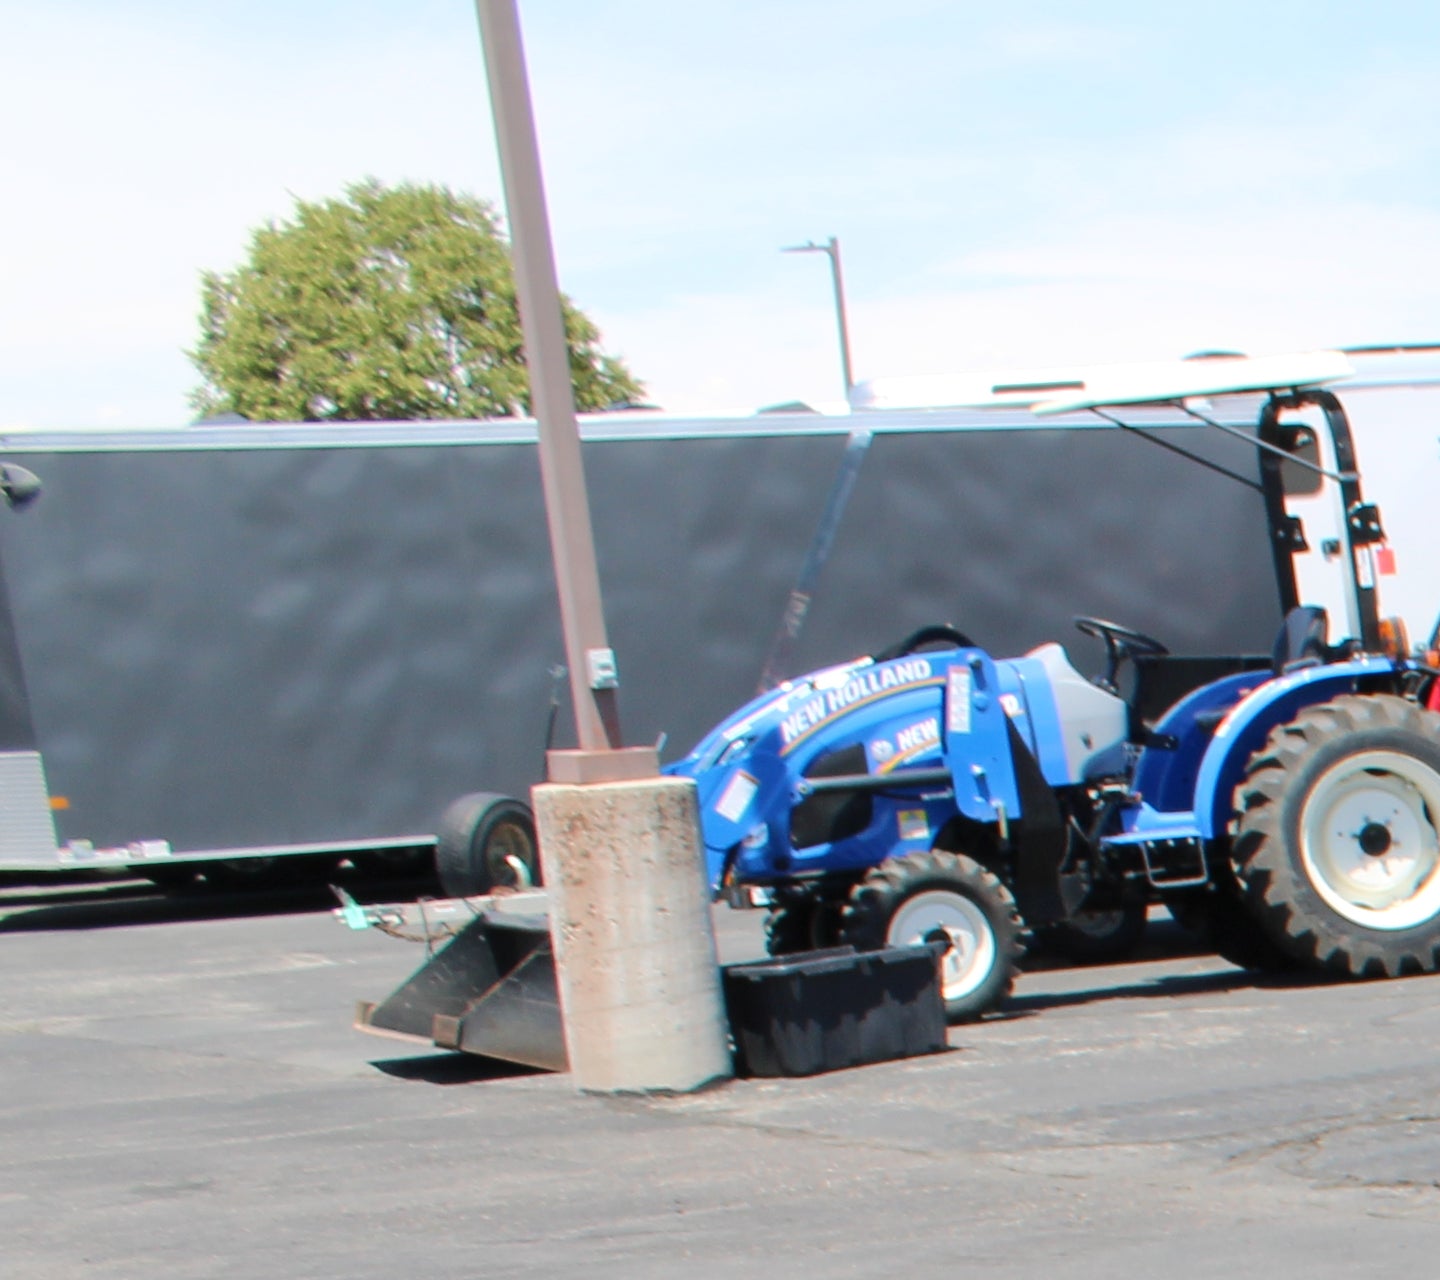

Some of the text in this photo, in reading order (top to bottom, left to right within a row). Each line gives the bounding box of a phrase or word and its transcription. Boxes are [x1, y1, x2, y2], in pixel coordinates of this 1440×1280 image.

[781, 658, 932, 743] NEW HOLLAND
[896, 717, 939, 751] NEW
